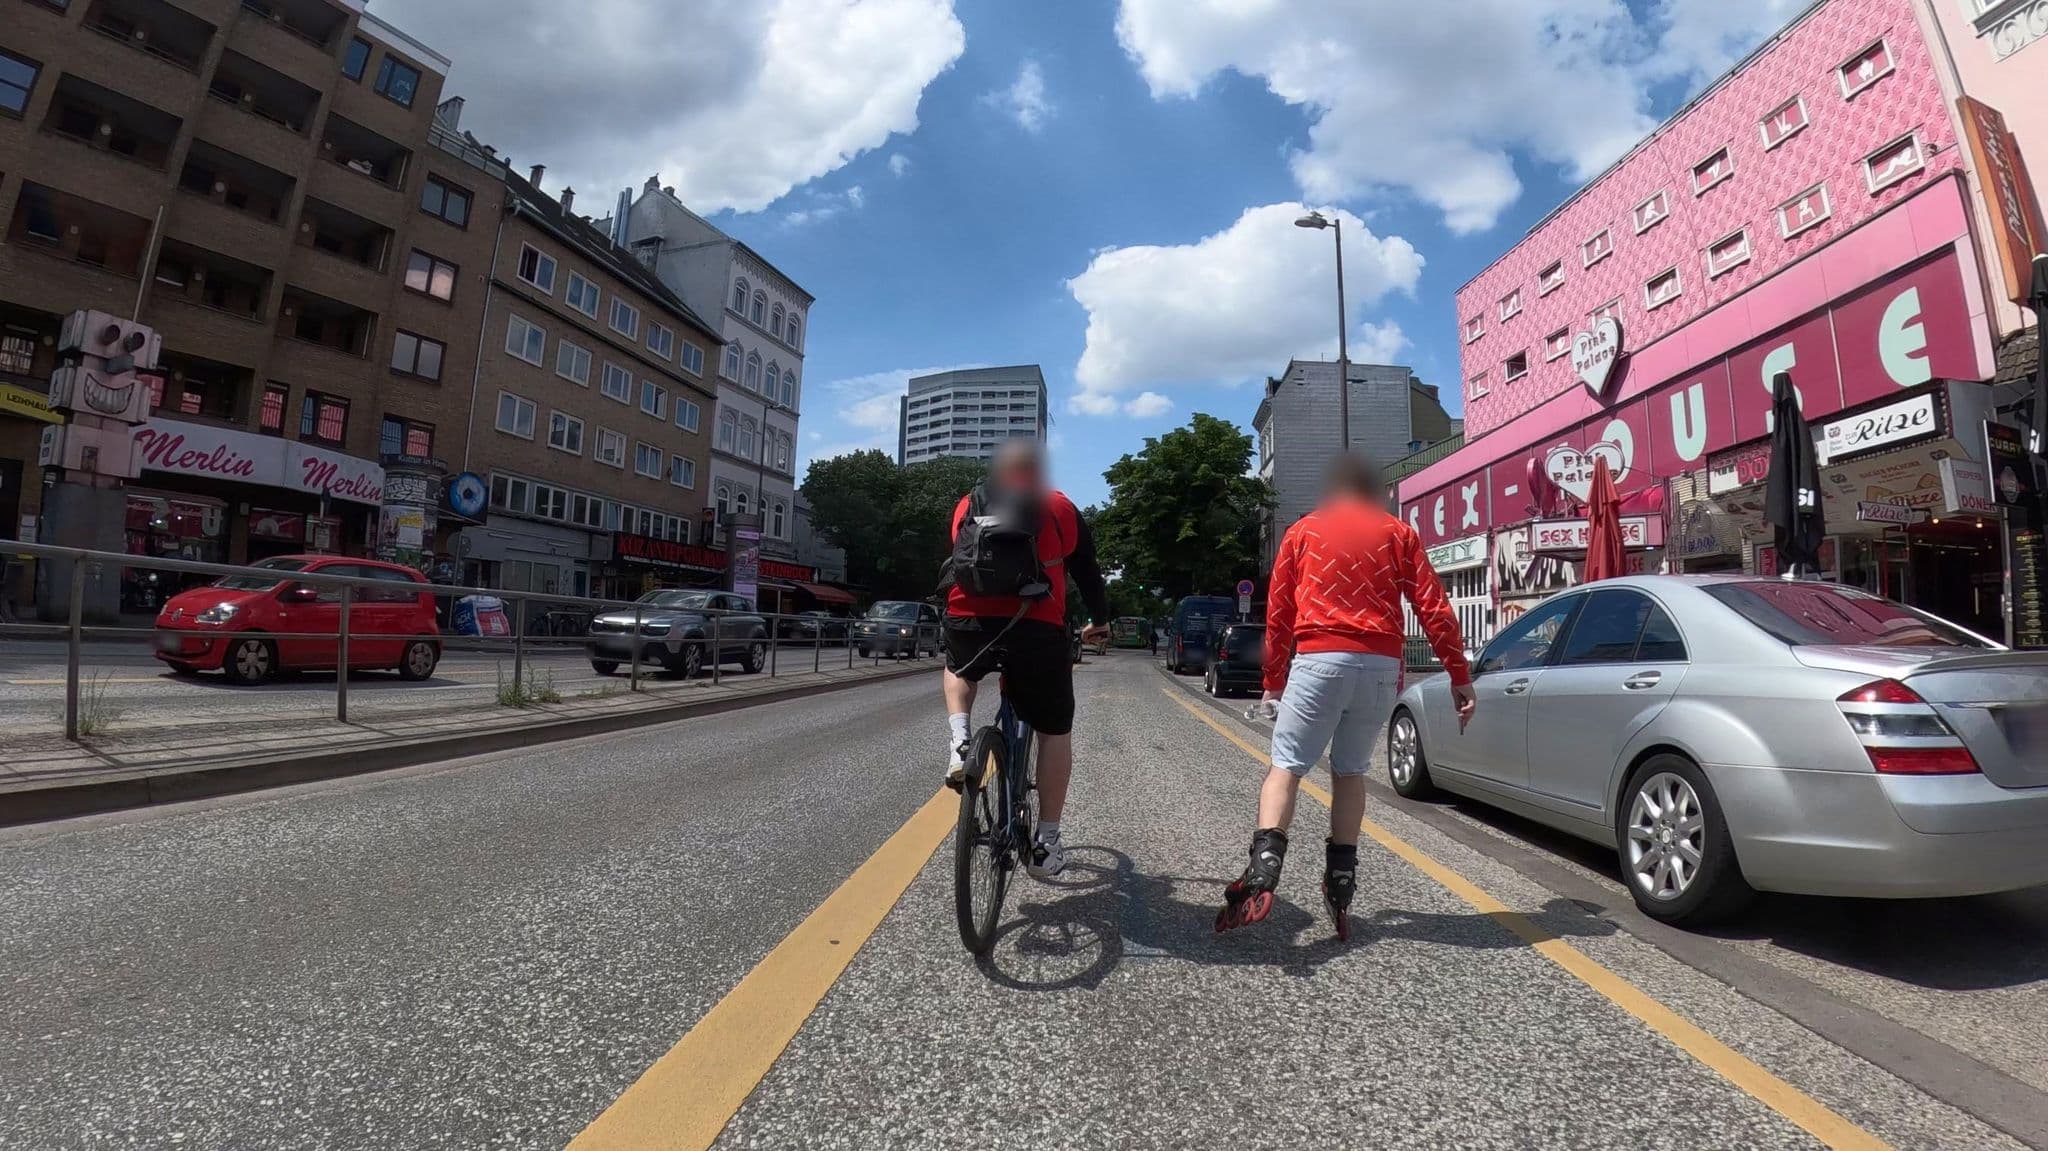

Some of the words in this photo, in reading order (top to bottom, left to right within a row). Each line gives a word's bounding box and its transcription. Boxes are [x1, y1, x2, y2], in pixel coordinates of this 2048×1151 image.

[1580, 331, 1607, 355] Pink
[7, 393, 51, 412] LEIHHAU
[1848, 407, 1930, 446] Ritze
[134, 429, 254, 477] Merlin
[1563, 452, 1601, 468] Pin
[303, 456, 383, 501] Merlin
[1552, 468, 1619, 483] Palae
[1540, 528, 1573, 546] SEX
[1578, 522, 1640, 545] HSE
